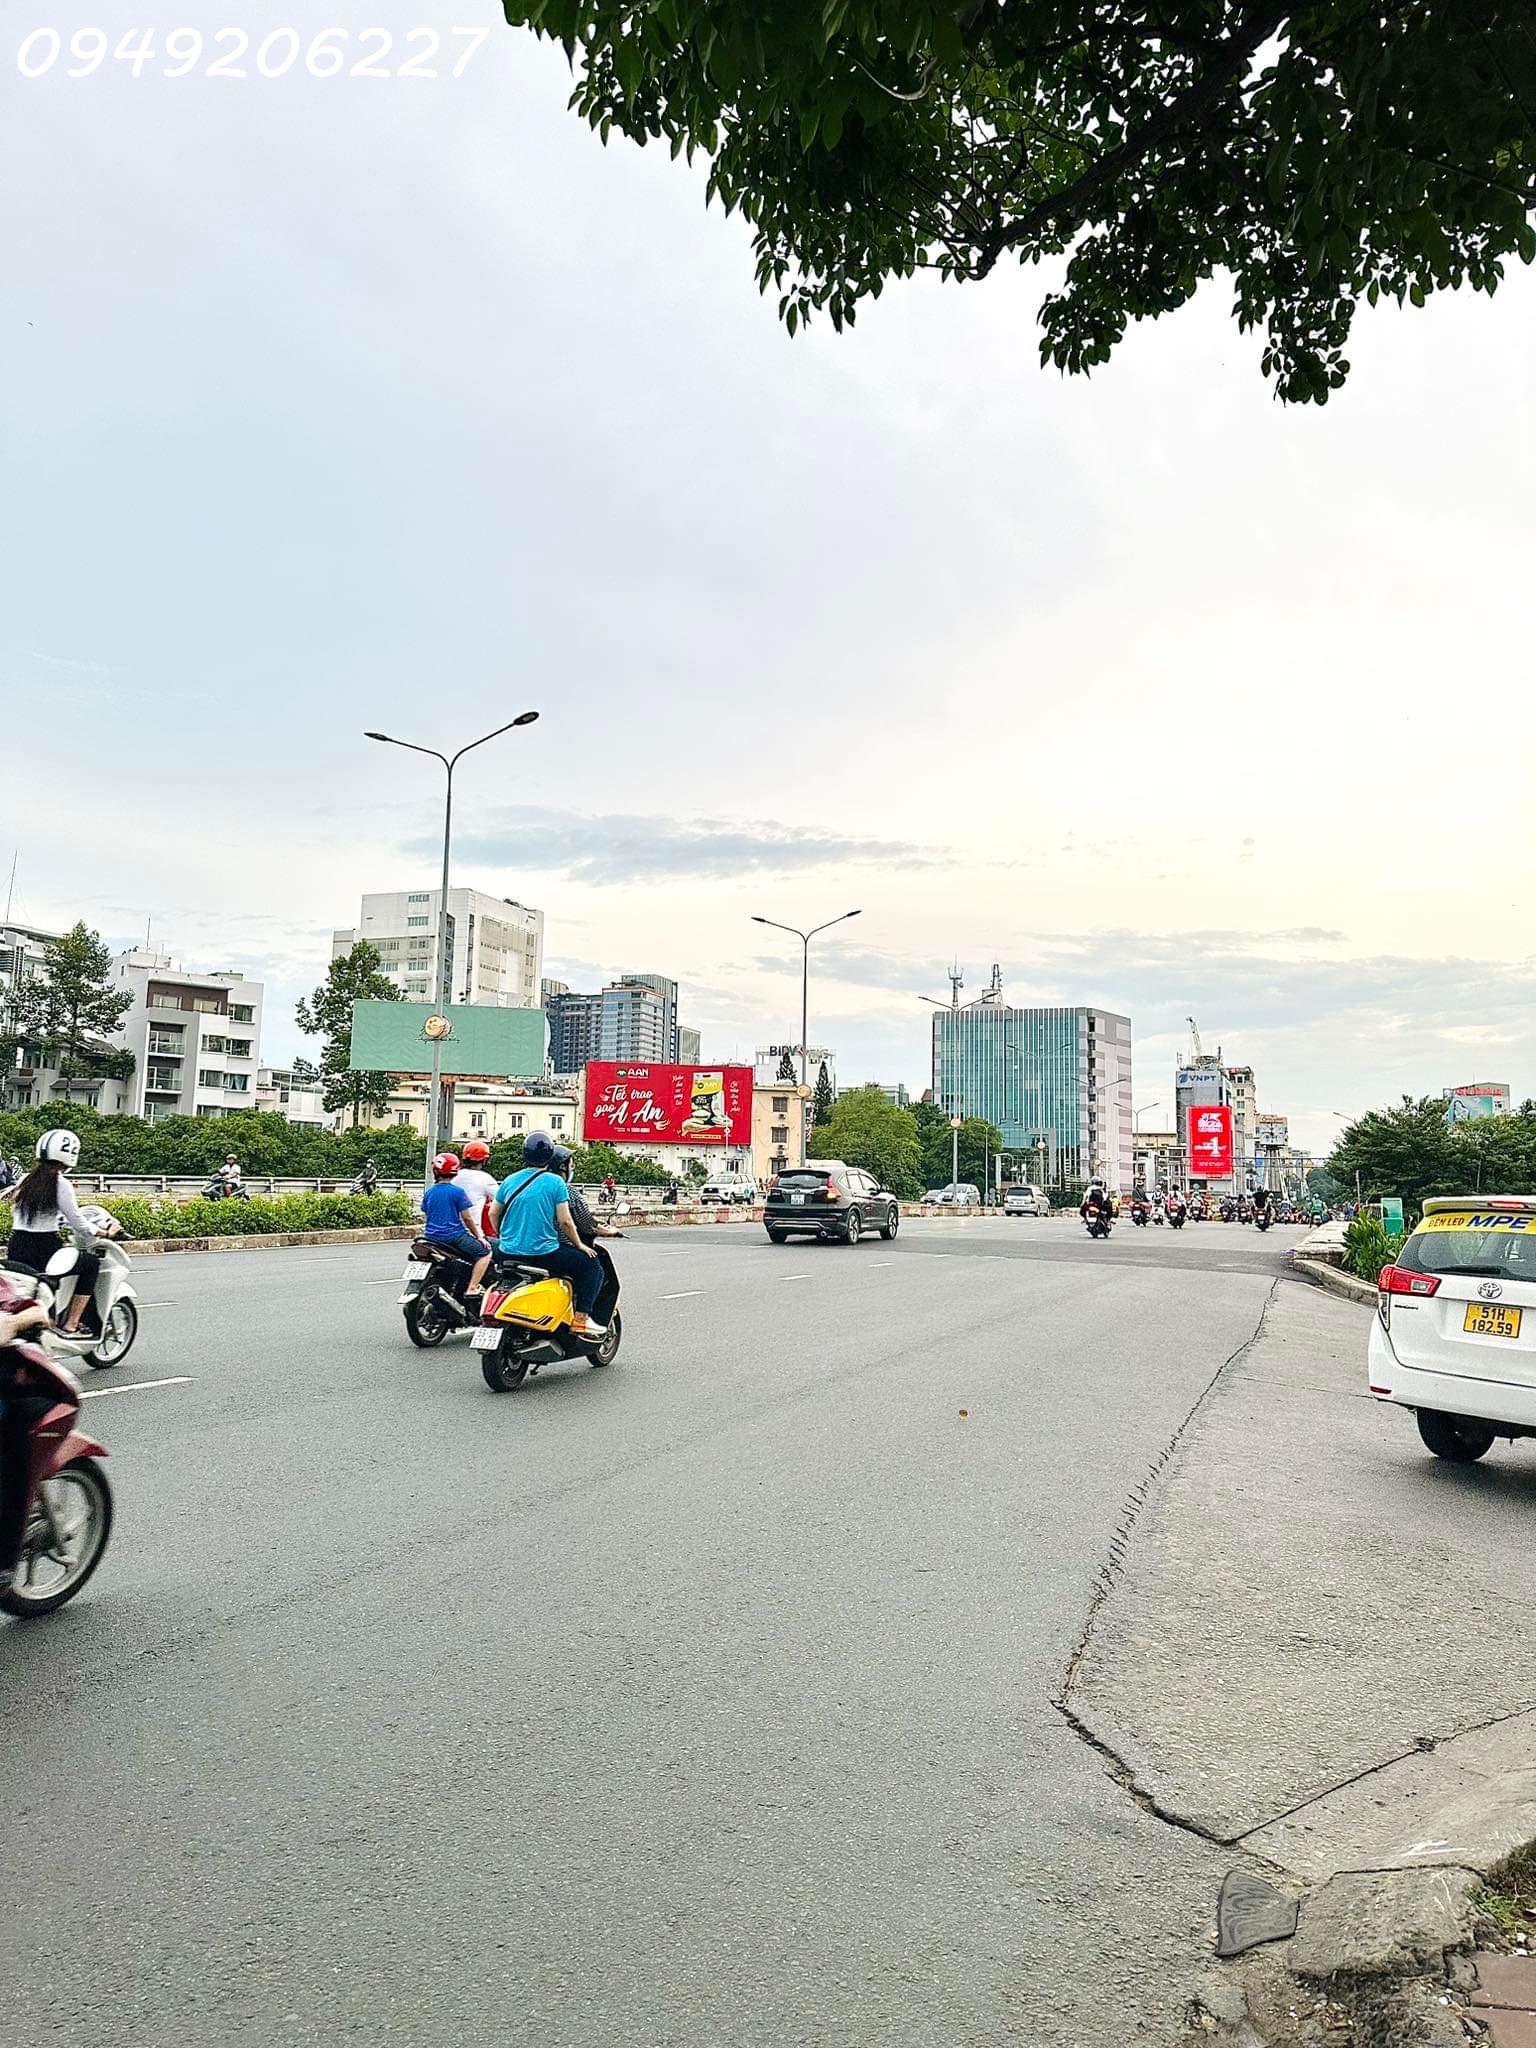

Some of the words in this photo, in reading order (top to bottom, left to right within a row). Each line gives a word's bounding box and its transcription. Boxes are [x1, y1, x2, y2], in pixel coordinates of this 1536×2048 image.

[630, 1089, 654, 1100] trao
[592, 1104, 616, 1118] gạo
[607, 1100, 629, 1125] A
[632, 1099, 664, 1123] An
[1447, 1216, 1465, 1226] LED
[1467, 1215, 1534, 1229] MPE
[1481, 1308, 1506, 1321] 51H
[1472, 1319, 1513, 1335] 182.59
